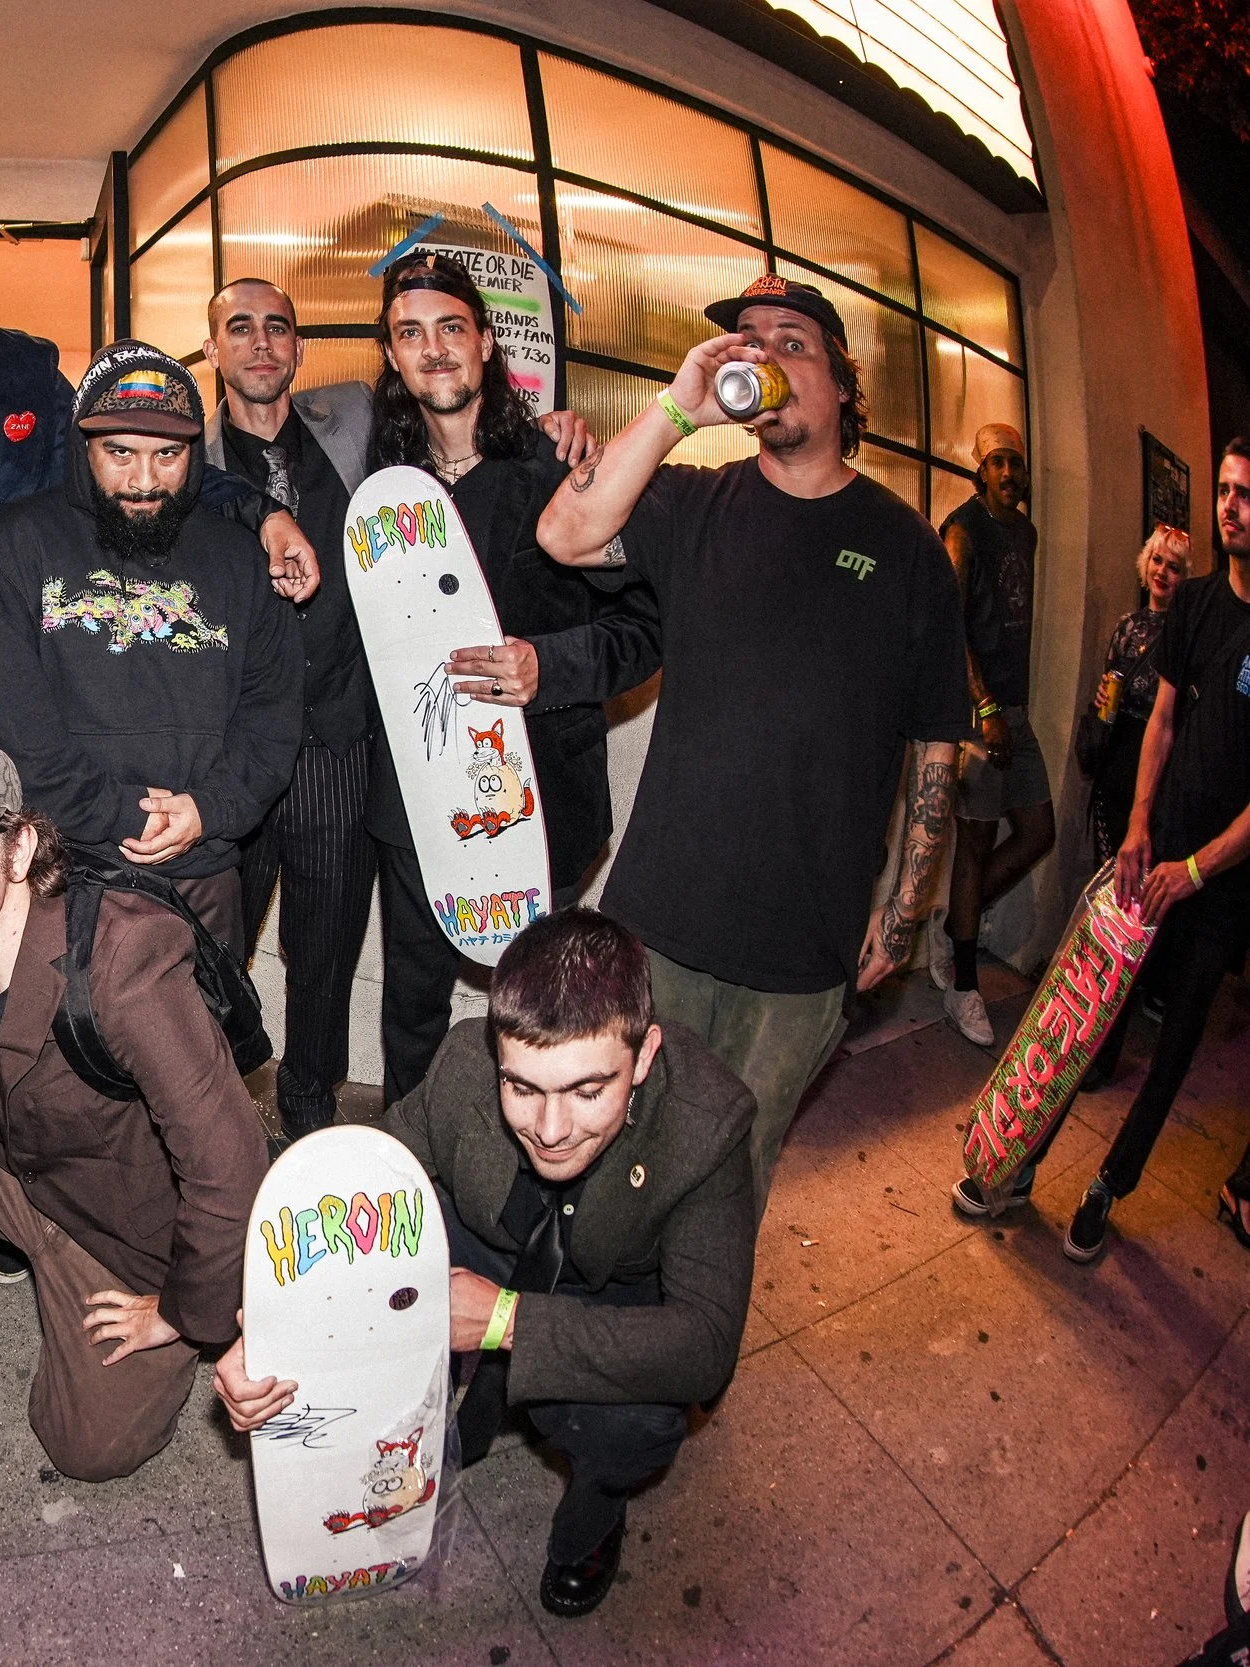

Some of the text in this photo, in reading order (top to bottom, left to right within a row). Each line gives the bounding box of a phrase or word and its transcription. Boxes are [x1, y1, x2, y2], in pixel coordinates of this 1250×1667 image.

[470, 274, 523, 293] REMIER
[486, 255, 507, 276] OR
[511, 258, 536, 280] DIE
[347, 499, 447, 572] HEROIN
[434, 887, 547, 938] HAYATE
[1005, 1042, 1054, 1111] OR
[964, 1087, 1024, 1183] DIE
[260, 1188, 424, 1287] HEROIN
